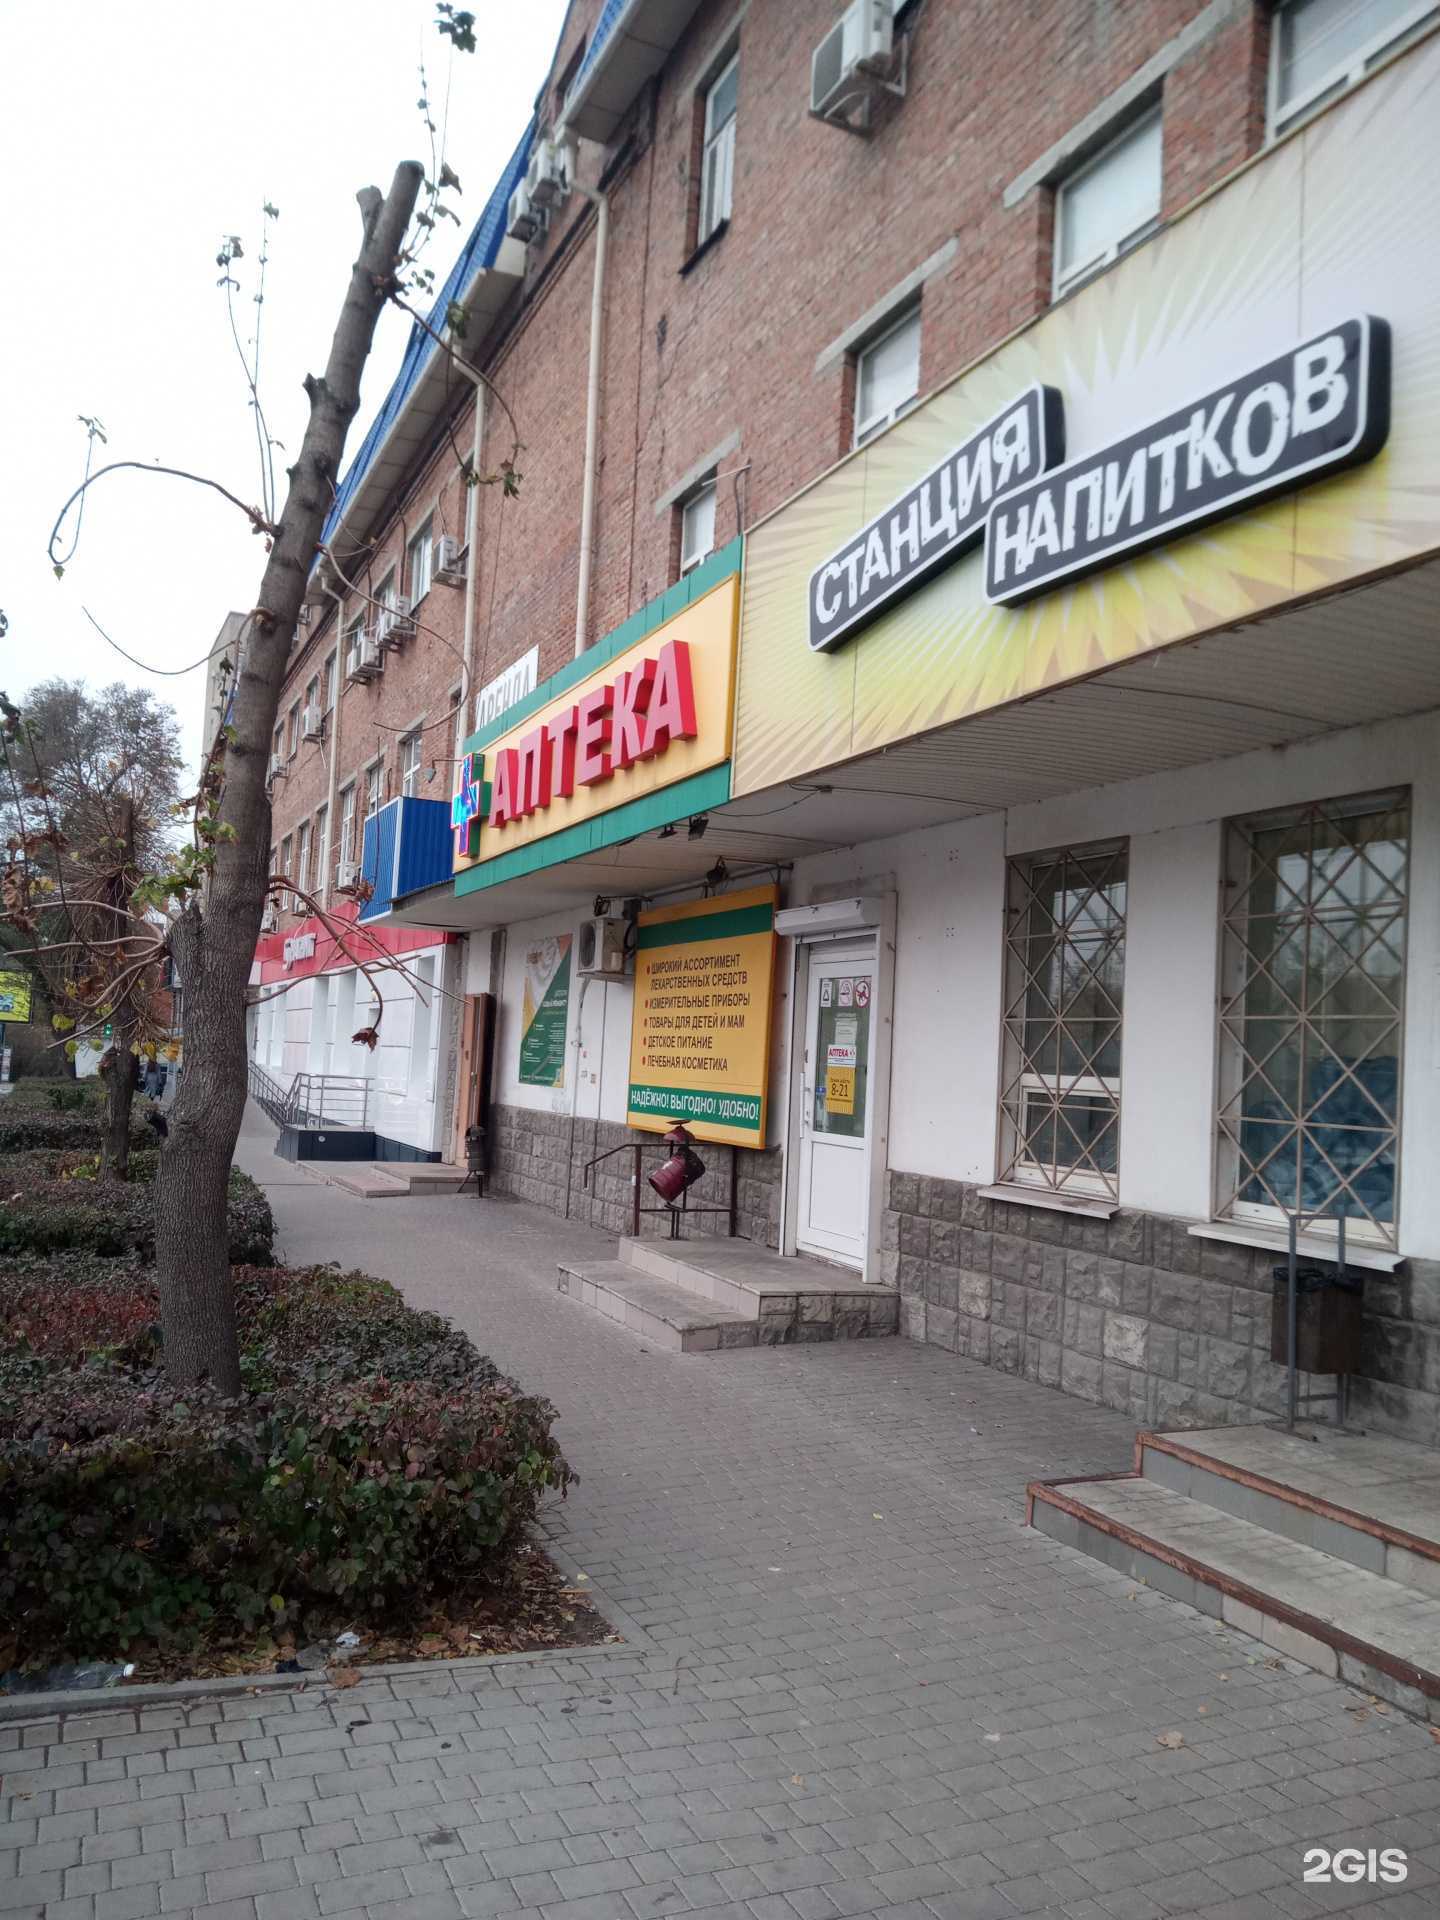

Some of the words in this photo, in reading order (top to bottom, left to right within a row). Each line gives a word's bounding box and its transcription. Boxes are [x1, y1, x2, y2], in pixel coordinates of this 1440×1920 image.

[992, 333, 1350, 584] НАПИТКОВ
[813, 404, 1032, 625] СТАНЦИЯ
[488, 640, 698, 828] АПТЕКА
[651, 960, 682, 974] ШИРОКИЙ
[683, 953, 741, 971] АССОРТИМЕНТ
[650, 974, 710, 991] ЛЕКАРСТВЕННЫХ
[712, 970, 748, 988] СРЕДСТВ
[649, 994, 710, 1009] ИЗМЕРИТЕЛЬНЫЕ
[711, 992, 750, 1007] ПРИБОРЫ
[648, 1016, 674, 1029] ТОВАРЫ
[674, 1015, 691, 1030] ДЛЯ
[692, 1012, 719, 1030] ДЕТЕЙ
[720, 1016, 726, 1029] И
[727, 1014, 745, 1028] МАМ
[647, 1035, 676, 1049] ДЕТСКОЕ
[676, 1036, 713, 1049] ПИТАНИЕ
[828, 1048, 849, 1057] АПТЕКА
[647, 1055, 681, 1068] ЛЕЧЕБНАЯ
[681, 1056, 728, 1071] КОСМЕТИКА
[631, 1088, 669, 1109] НАДЁЖНО!
[670, 1094, 717, 1115] ВЫГОДНО!
[718, 1099, 760, 1121] УДОБНО!
